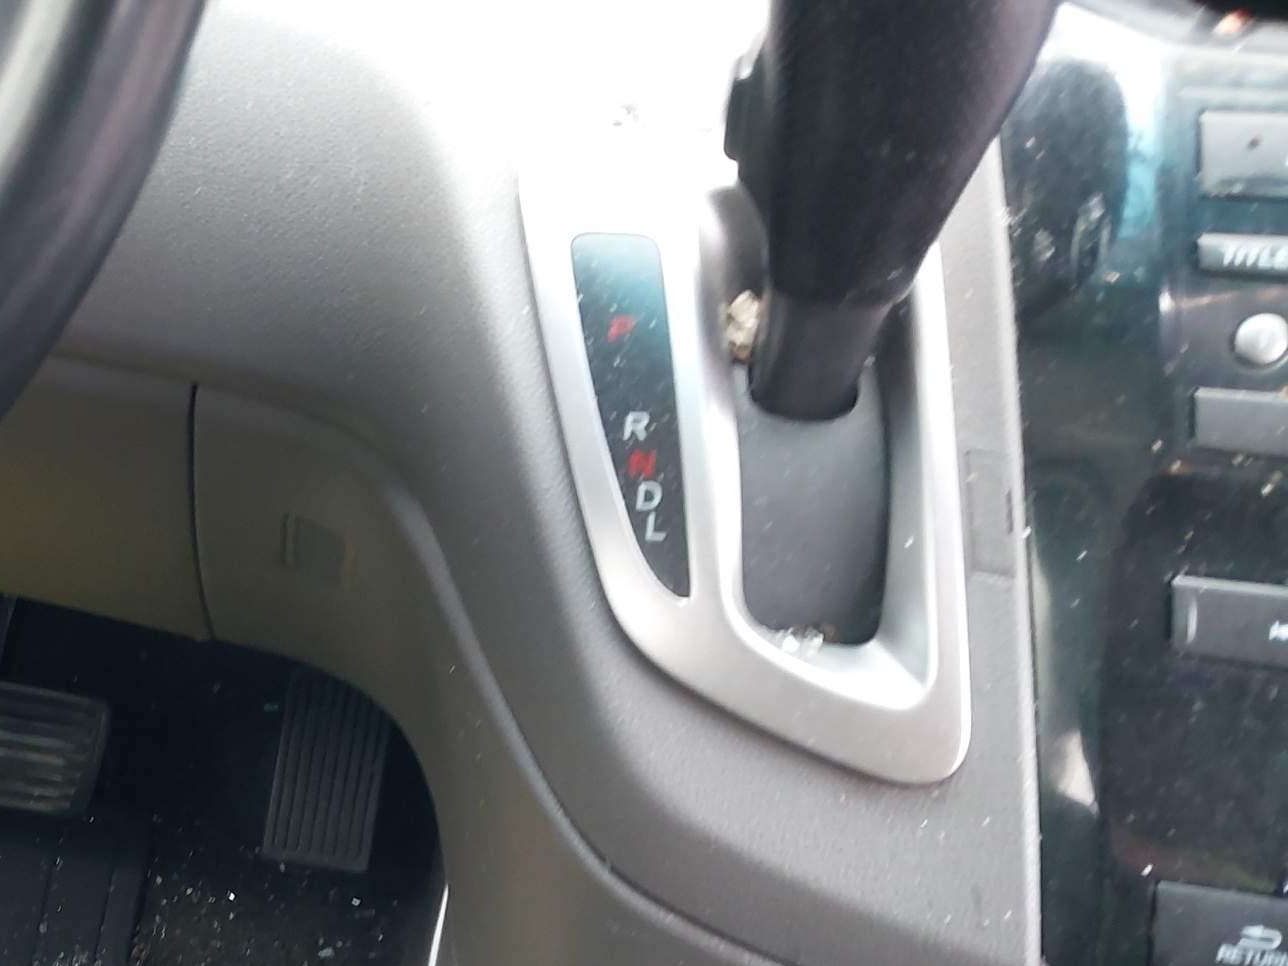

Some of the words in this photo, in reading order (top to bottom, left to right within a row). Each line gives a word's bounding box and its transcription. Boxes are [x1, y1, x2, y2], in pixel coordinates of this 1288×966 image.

[622, 410, 651, 442] R
[628, 448, 658, 480] N
[634, 480, 664, 513] D
[644, 510, 668, 543] L
